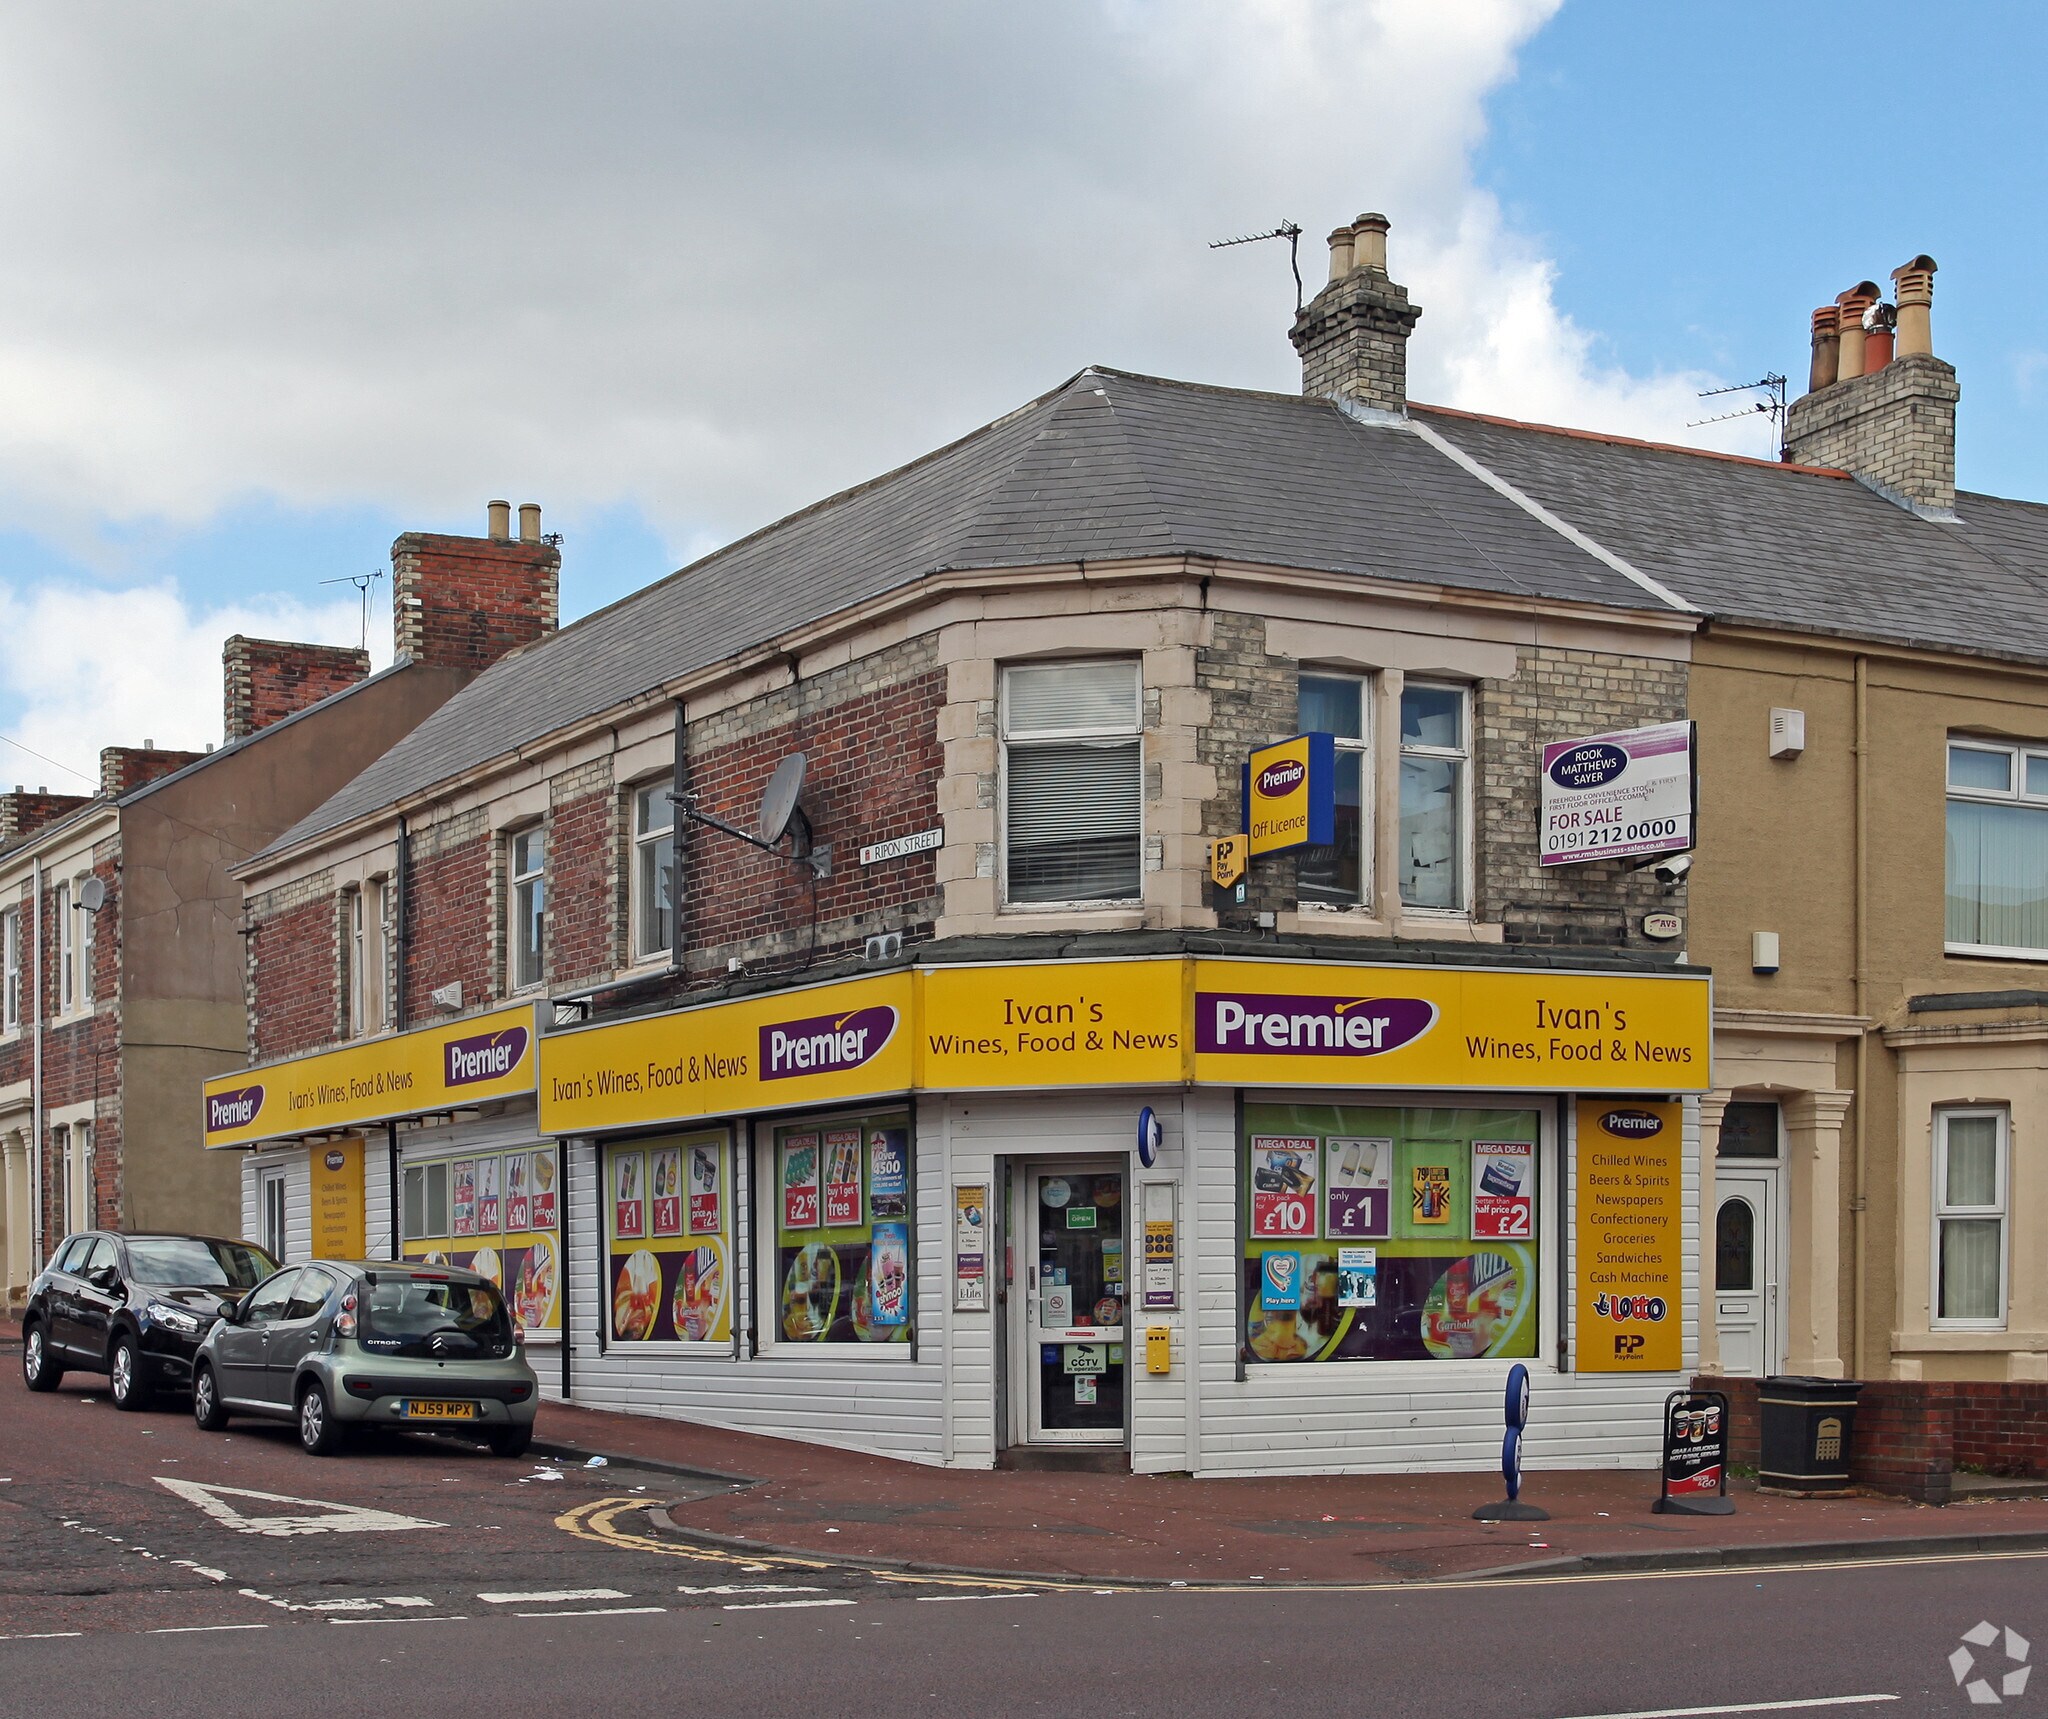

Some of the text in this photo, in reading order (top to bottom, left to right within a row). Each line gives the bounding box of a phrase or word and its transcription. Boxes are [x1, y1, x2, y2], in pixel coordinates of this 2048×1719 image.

[1575, 748, 1603, 762] ROOK
[1561, 758, 1617, 776] MATTHEWS
[1263, 766, 1303, 789] Premier
[1574, 772, 1603, 786] SAYER
[1549, 794, 1582, 805] FREEHOLD
[1583, 786, 1630, 801] CONVENIENCE
[1549, 804, 1566, 812] FIRST
[1567, 800, 1589, 810] FLOOR
[1549, 806, 1623, 831] FOR SALE
[1253, 815, 1306, 839] Off Licence
[1549, 819, 1676, 851] 0191 212 0000
[875, 832, 938, 860] RIPON STREET
[1217, 861, 1228, 872] Pay
[1217, 869, 1234, 880] Point
[1660, 920, 1677, 928] AVS
[1003, 996, 1104, 1026] Ivan's
[1536, 999, 1627, 1031] Ivan's
[1215, 1000, 1390, 1049] Premier
[771, 1026, 868, 1073] Premier
[929, 1028, 1179, 1058] Wines, Food & News
[1466, 1036, 1692, 1064] Wines, Food & News
[451, 1042, 512, 1081] Premier
[552, 1052, 747, 1102] Ivan's Wines, Food & News
[289, 1070, 414, 1112] Ivan's Wines, Food & News
[211, 1095, 254, 1128] Premier
[1609, 1114, 1660, 1130] Premier
[828, 1133, 844, 1143] MEGA
[1257, 1139, 1312, 1150] MEGA DEAL
[879, 1151, 896, 1160] Over
[1477, 1145, 1527, 1154] MEGA DEAL
[326, 1154, 344, 1165] Premier
[1592, 1154, 1667, 1167] Chilled Wines
[873, 1160, 901, 1175] 4500
[321, 1183, 347, 1193] Chilled Wines
[1589, 1174, 1670, 1188] Beers & Spirits
[827, 1186, 838, 1198] buy
[839, 1185, 843, 1195] 1
[844, 1186, 854, 1198] get
[1276, 1194, 1291, 1202] pack
[1330, 1191, 1350, 1203] only
[533, 1195, 543, 1207] half
[691, 1196, 702, 1208] half
[790, 1194, 817, 1220] £2.99
[828, 1197, 850, 1217] free
[1596, 1193, 1664, 1208] Newspapers
[482, 1202, 498, 1226] £14
[509, 1204, 526, 1227] £10
[534, 1206, 545, 1219] price
[624, 1202, 636, 1229] £1
[661, 1199, 673, 1226] £1
[692, 1208, 706, 1221] price
[1264, 1201, 1307, 1230] £10
[1342, 1196, 1372, 1228] £1
[1475, 1205, 1510, 1215] half price
[1498, 1204, 1528, 1234] £2
[1590, 1212, 1668, 1228] Confectionery
[1603, 1232, 1656, 1244] Groceries
[1596, 1252, 1662, 1265] Sandwiches
[1590, 1271, 1669, 1284] Cash Machine
[1071, 1359, 1098, 1367] CCTV
[1614, 1353, 1644, 1361] PayPoint
[410, 1403, 471, 1416] NJ59 MPX
[1692, 1443, 1720, 1453] DELICIOUS
[1700, 1450, 1721, 1458] SERVED
